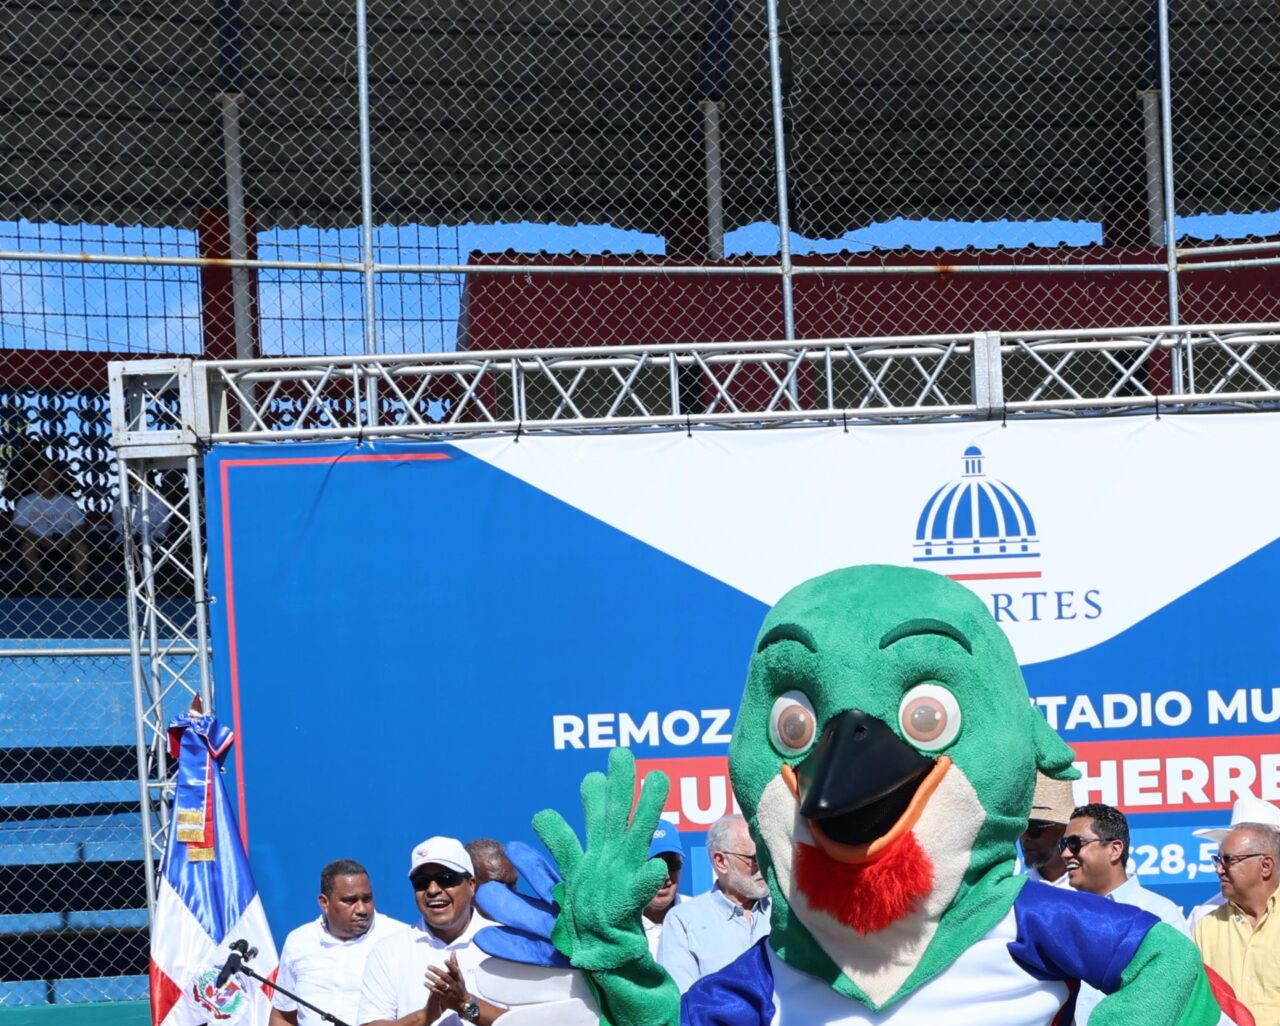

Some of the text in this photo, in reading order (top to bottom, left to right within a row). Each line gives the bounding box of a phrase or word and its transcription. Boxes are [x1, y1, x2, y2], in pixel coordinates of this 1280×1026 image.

[990, 589, 1102, 622] RTES
[553, 708, 732, 750] REMOZ
[1029, 691, 1192, 730] TADIO
